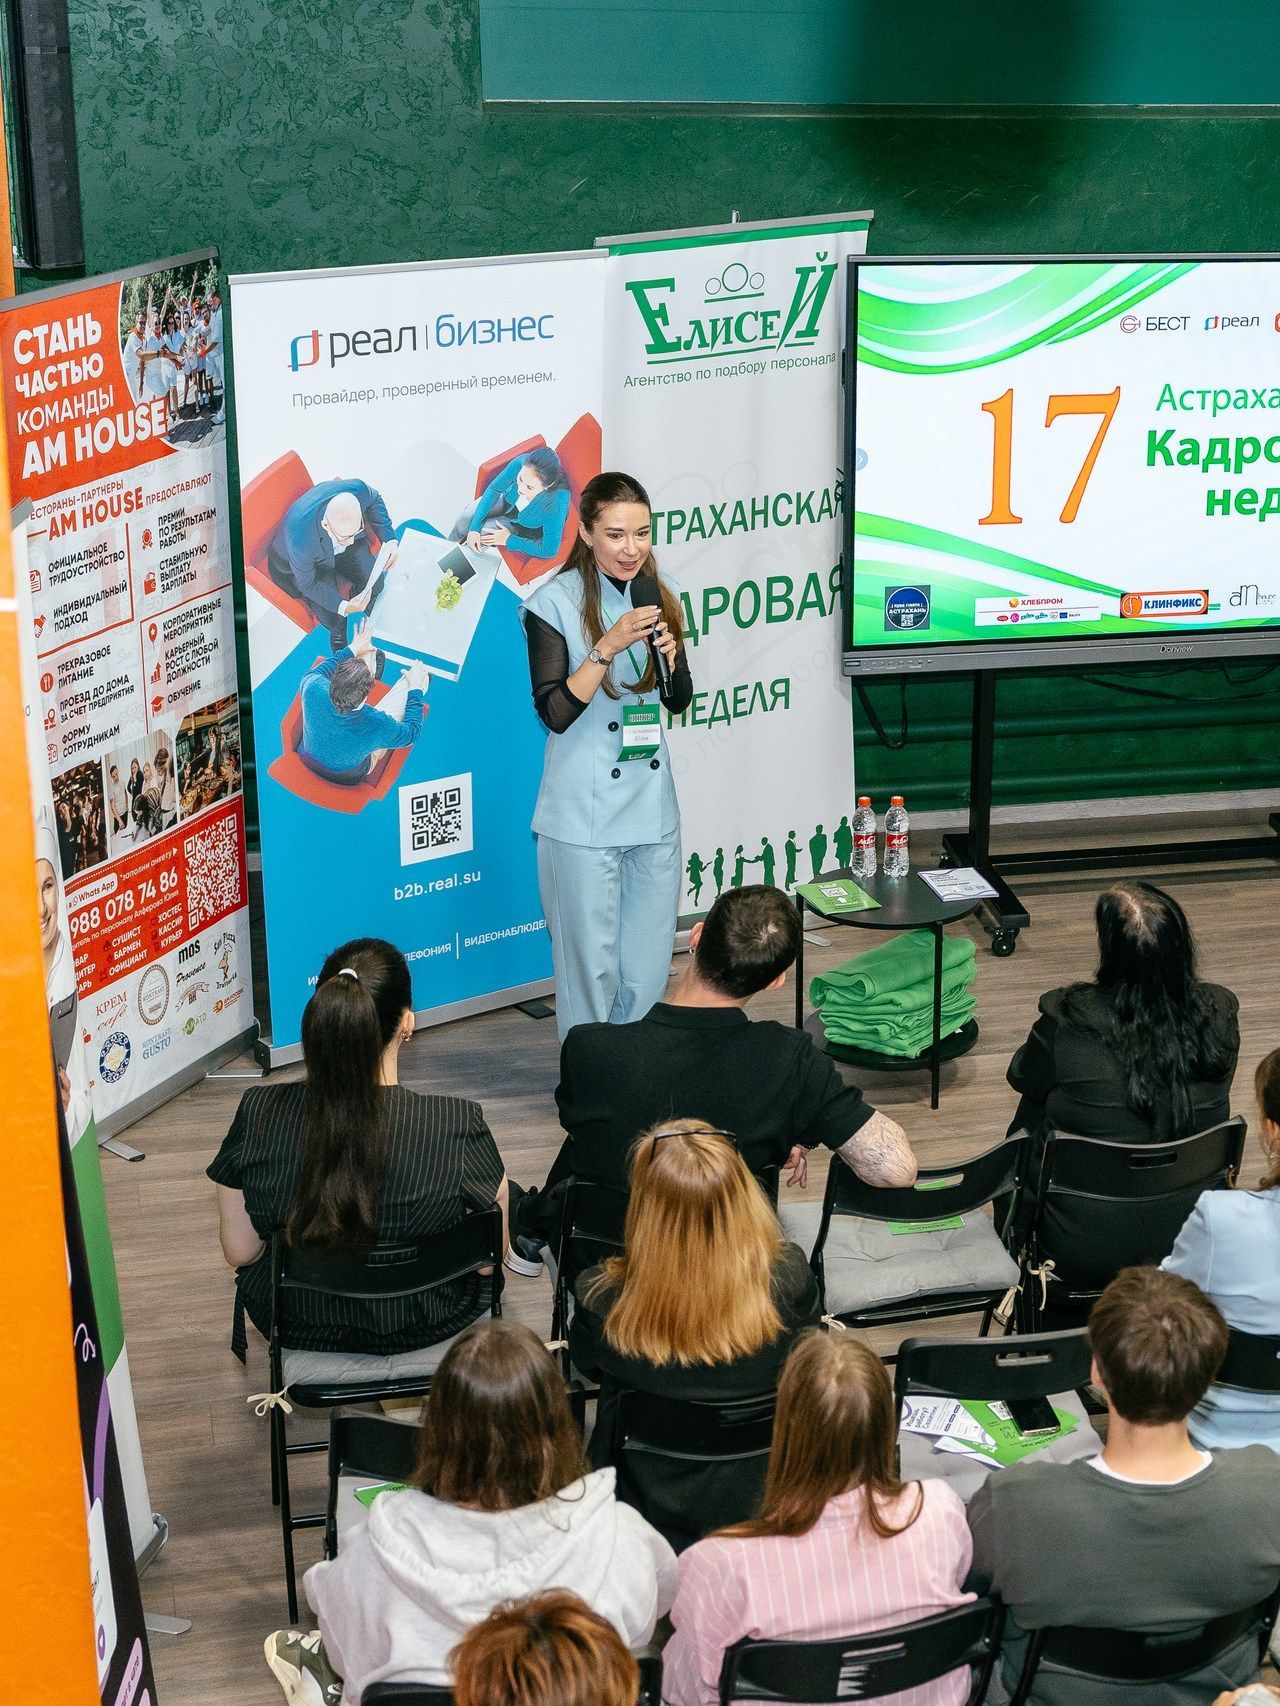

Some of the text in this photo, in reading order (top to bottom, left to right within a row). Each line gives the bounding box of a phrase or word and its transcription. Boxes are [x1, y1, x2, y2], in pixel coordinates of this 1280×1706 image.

[1146, 316, 1191, 331] БЕСТ
[1221, 314, 1260, 330] реал
[13, 313, 102, 365] СТАНЬ
[330, 314, 554, 368] реал бизнес
[15, 353, 104, 399] ЧАСТЬЮ
[624, 353, 836, 388] Агентство по подбору персонала
[292, 371, 556, 408] Провайдер, проверенный временем.
[17, 384, 114, 433] КОМАНДЫ
[22, 399, 168, 479] AM HOUSE
[977, 386, 1121, 526] 17
[145, 472, 212, 506] ПРЕДОСТАВЛЯЮТ
[49, 486, 144, 541] AM HOUSE
[158, 507, 185, 526] ПРЕМИИ
[158, 508, 217, 538] ПО РЕЗУЛЬТАТАМ
[160, 531, 186, 550] РАБОТЫ
[48, 541, 108, 573] ОФИЦИАЛЬНОЕ
[49, 550, 125, 587] ТРУДОУСТРОЙСТВО
[159, 544, 208, 570] СТАБИЛЬНУЮ
[160, 560, 191, 582] ВЫПЛАТУ
[161, 570, 197, 594] ЗАРПЛАТЫ
[53, 580, 128, 619] ИНДИВИДУАЛЬНЫЙ
[162, 598, 222, 630] КОРПОРАТИВНЫЕ
[680, 564, 843, 646] ДРОВАЯ
[1021, 598, 1063, 606] ХЛЕБПРОМ
[1144, 599, 1202, 610] КЛИНФИКС
[54, 611, 88, 633] ПОДХОД
[163, 613, 214, 643] МЕРОПРИЯТИЯ
[57, 645, 111, 676] ТРЕХРАЗОВОЕ
[164, 632, 205, 661] КАРЬЕРНЫЙ
[165, 638, 219, 672] РОСТ ЛЮБОЙ
[58, 666, 94, 690] ПИТАНИЕ
[166, 656, 211, 685] ДОЛЖНОСТИ
[59, 674, 130, 712] ПРОЕЗД ДО ДОМА
[71, 685, 135, 721] СЧЕТ ПРЕДПРИЯТИЯ
[167, 680, 201, 704] ОБУЧЕНИЕ
[62, 724, 91, 746] ФОРМУ
[63, 725, 120, 758] СОТРУДНИКАМ
[79, 878, 115, 902] Whats App
[394, 871, 481, 901] b2b.real.su
[70, 866, 178, 940] 988 078 74 86
[157, 903, 182, 923] ХОСТЕС
[112, 926, 141, 948] СУШИСТ
[158, 915, 183, 936] КАССИР
[160, 929, 183, 949] КУРЬЕР
[404, 919, 547, 962] ЛЕФОНИЯ ВИДЕОНАБЛЮДЕ
[108, 949, 148, 976] ОФИЦИАНТ
[113, 940, 142, 960] БАРМЕН
[143, 1036, 171, 1060] GUSTO
